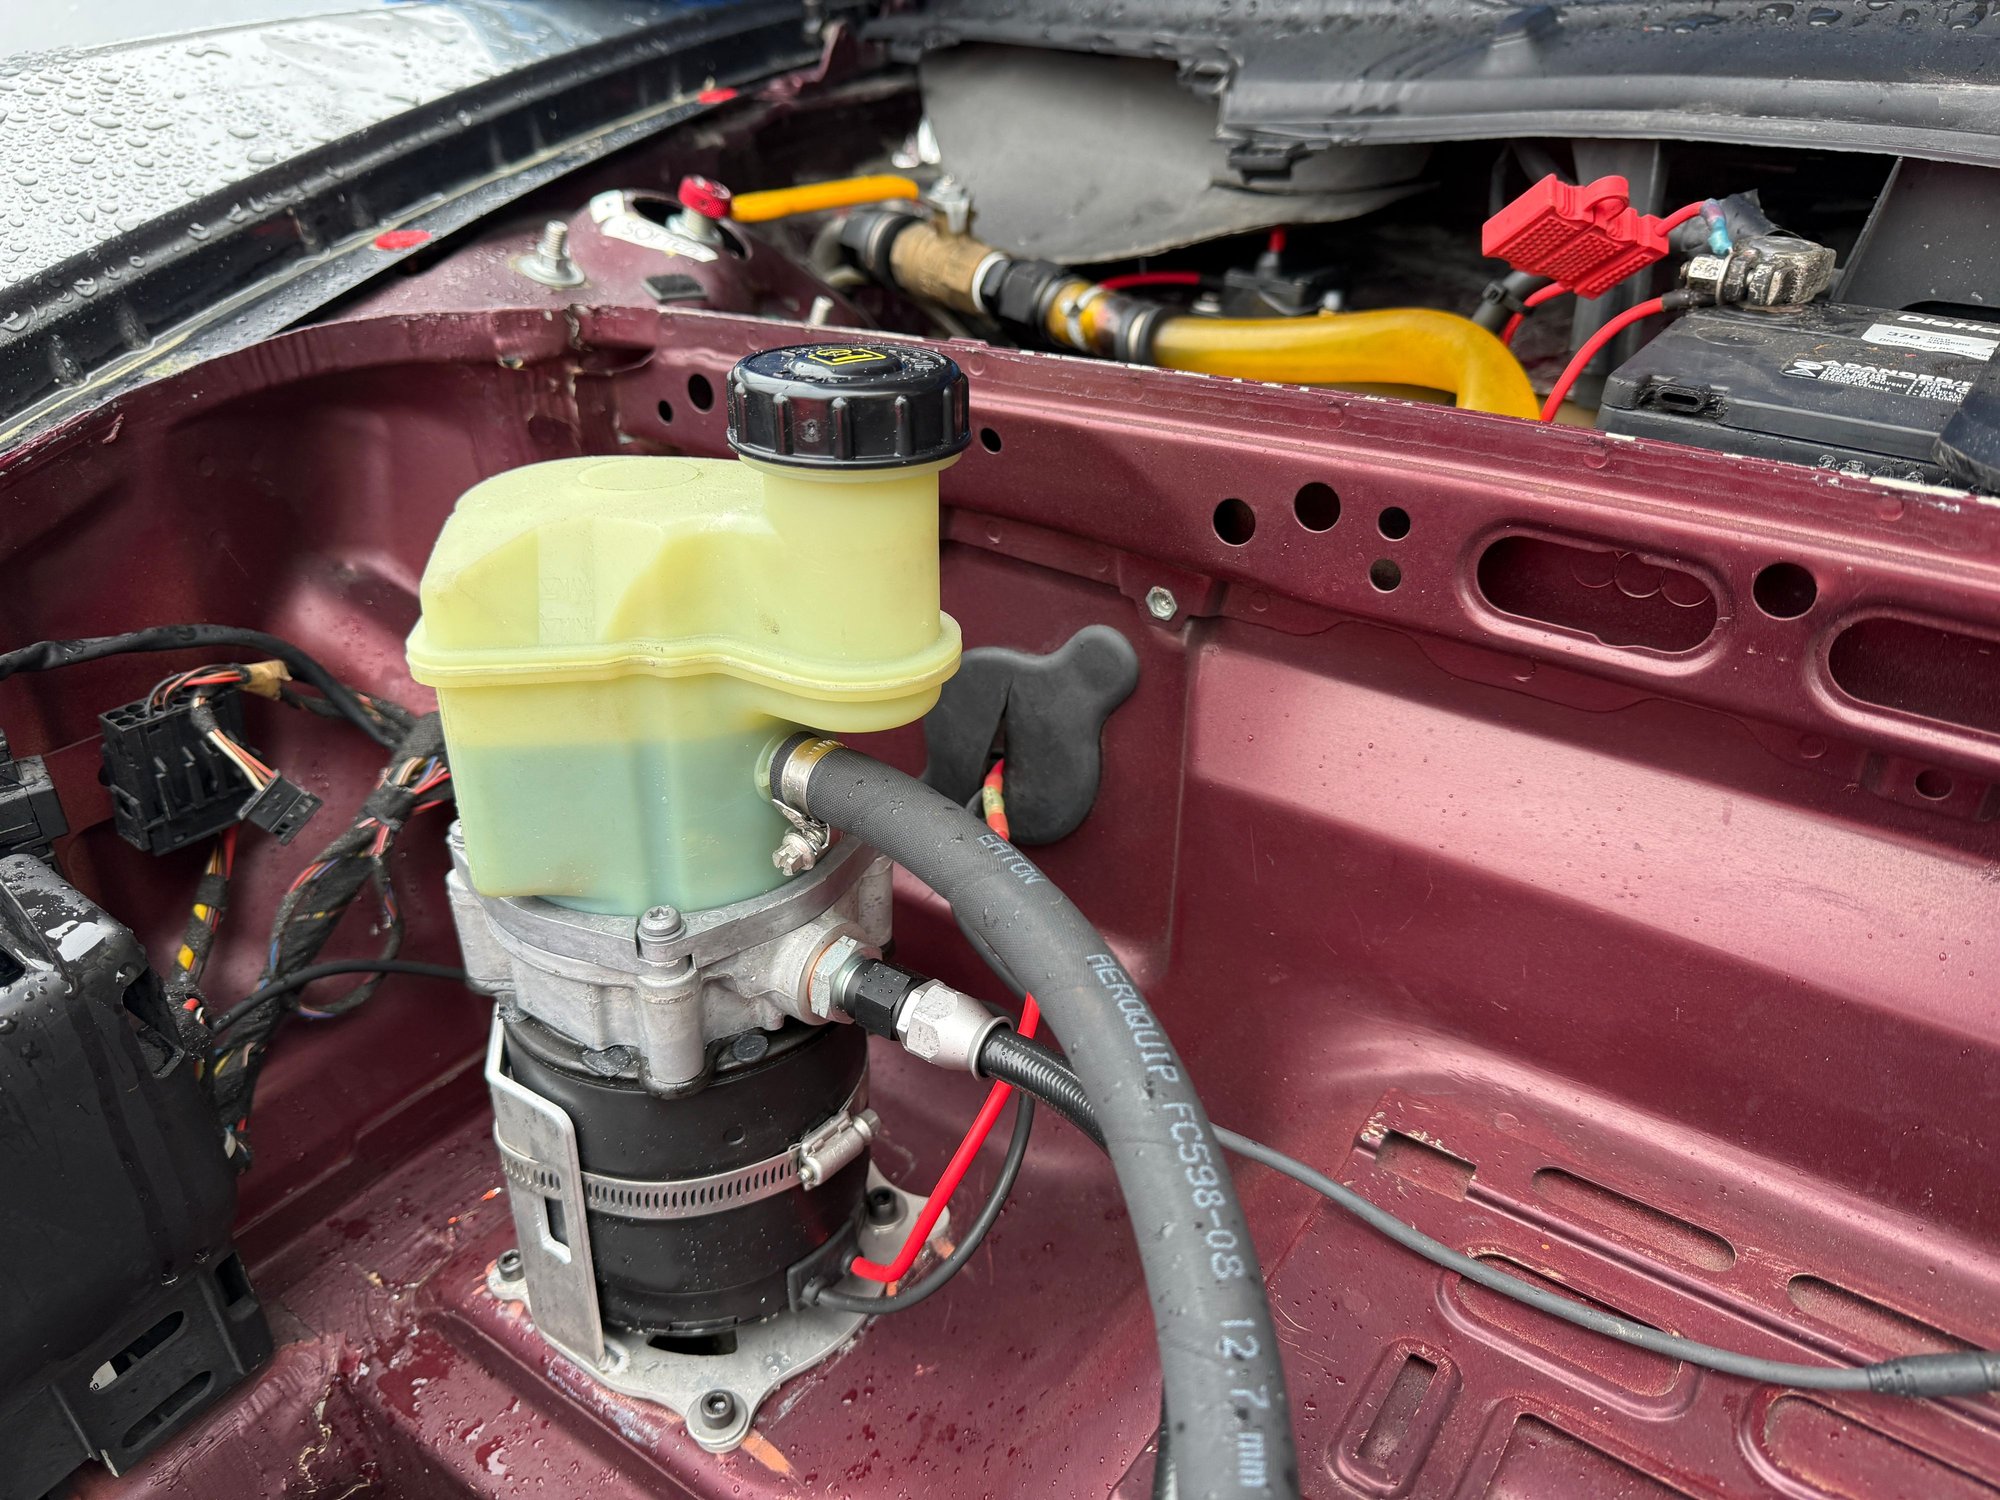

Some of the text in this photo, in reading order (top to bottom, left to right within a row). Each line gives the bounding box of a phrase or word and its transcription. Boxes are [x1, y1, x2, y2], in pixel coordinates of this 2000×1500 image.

[976, 834, 1046, 885] EATON
[1086, 953, 1180, 1083] AEROQUIP
[1219, 1317, 1271, 1409] 12.7
[1236, 1431, 1267, 1488] mm
